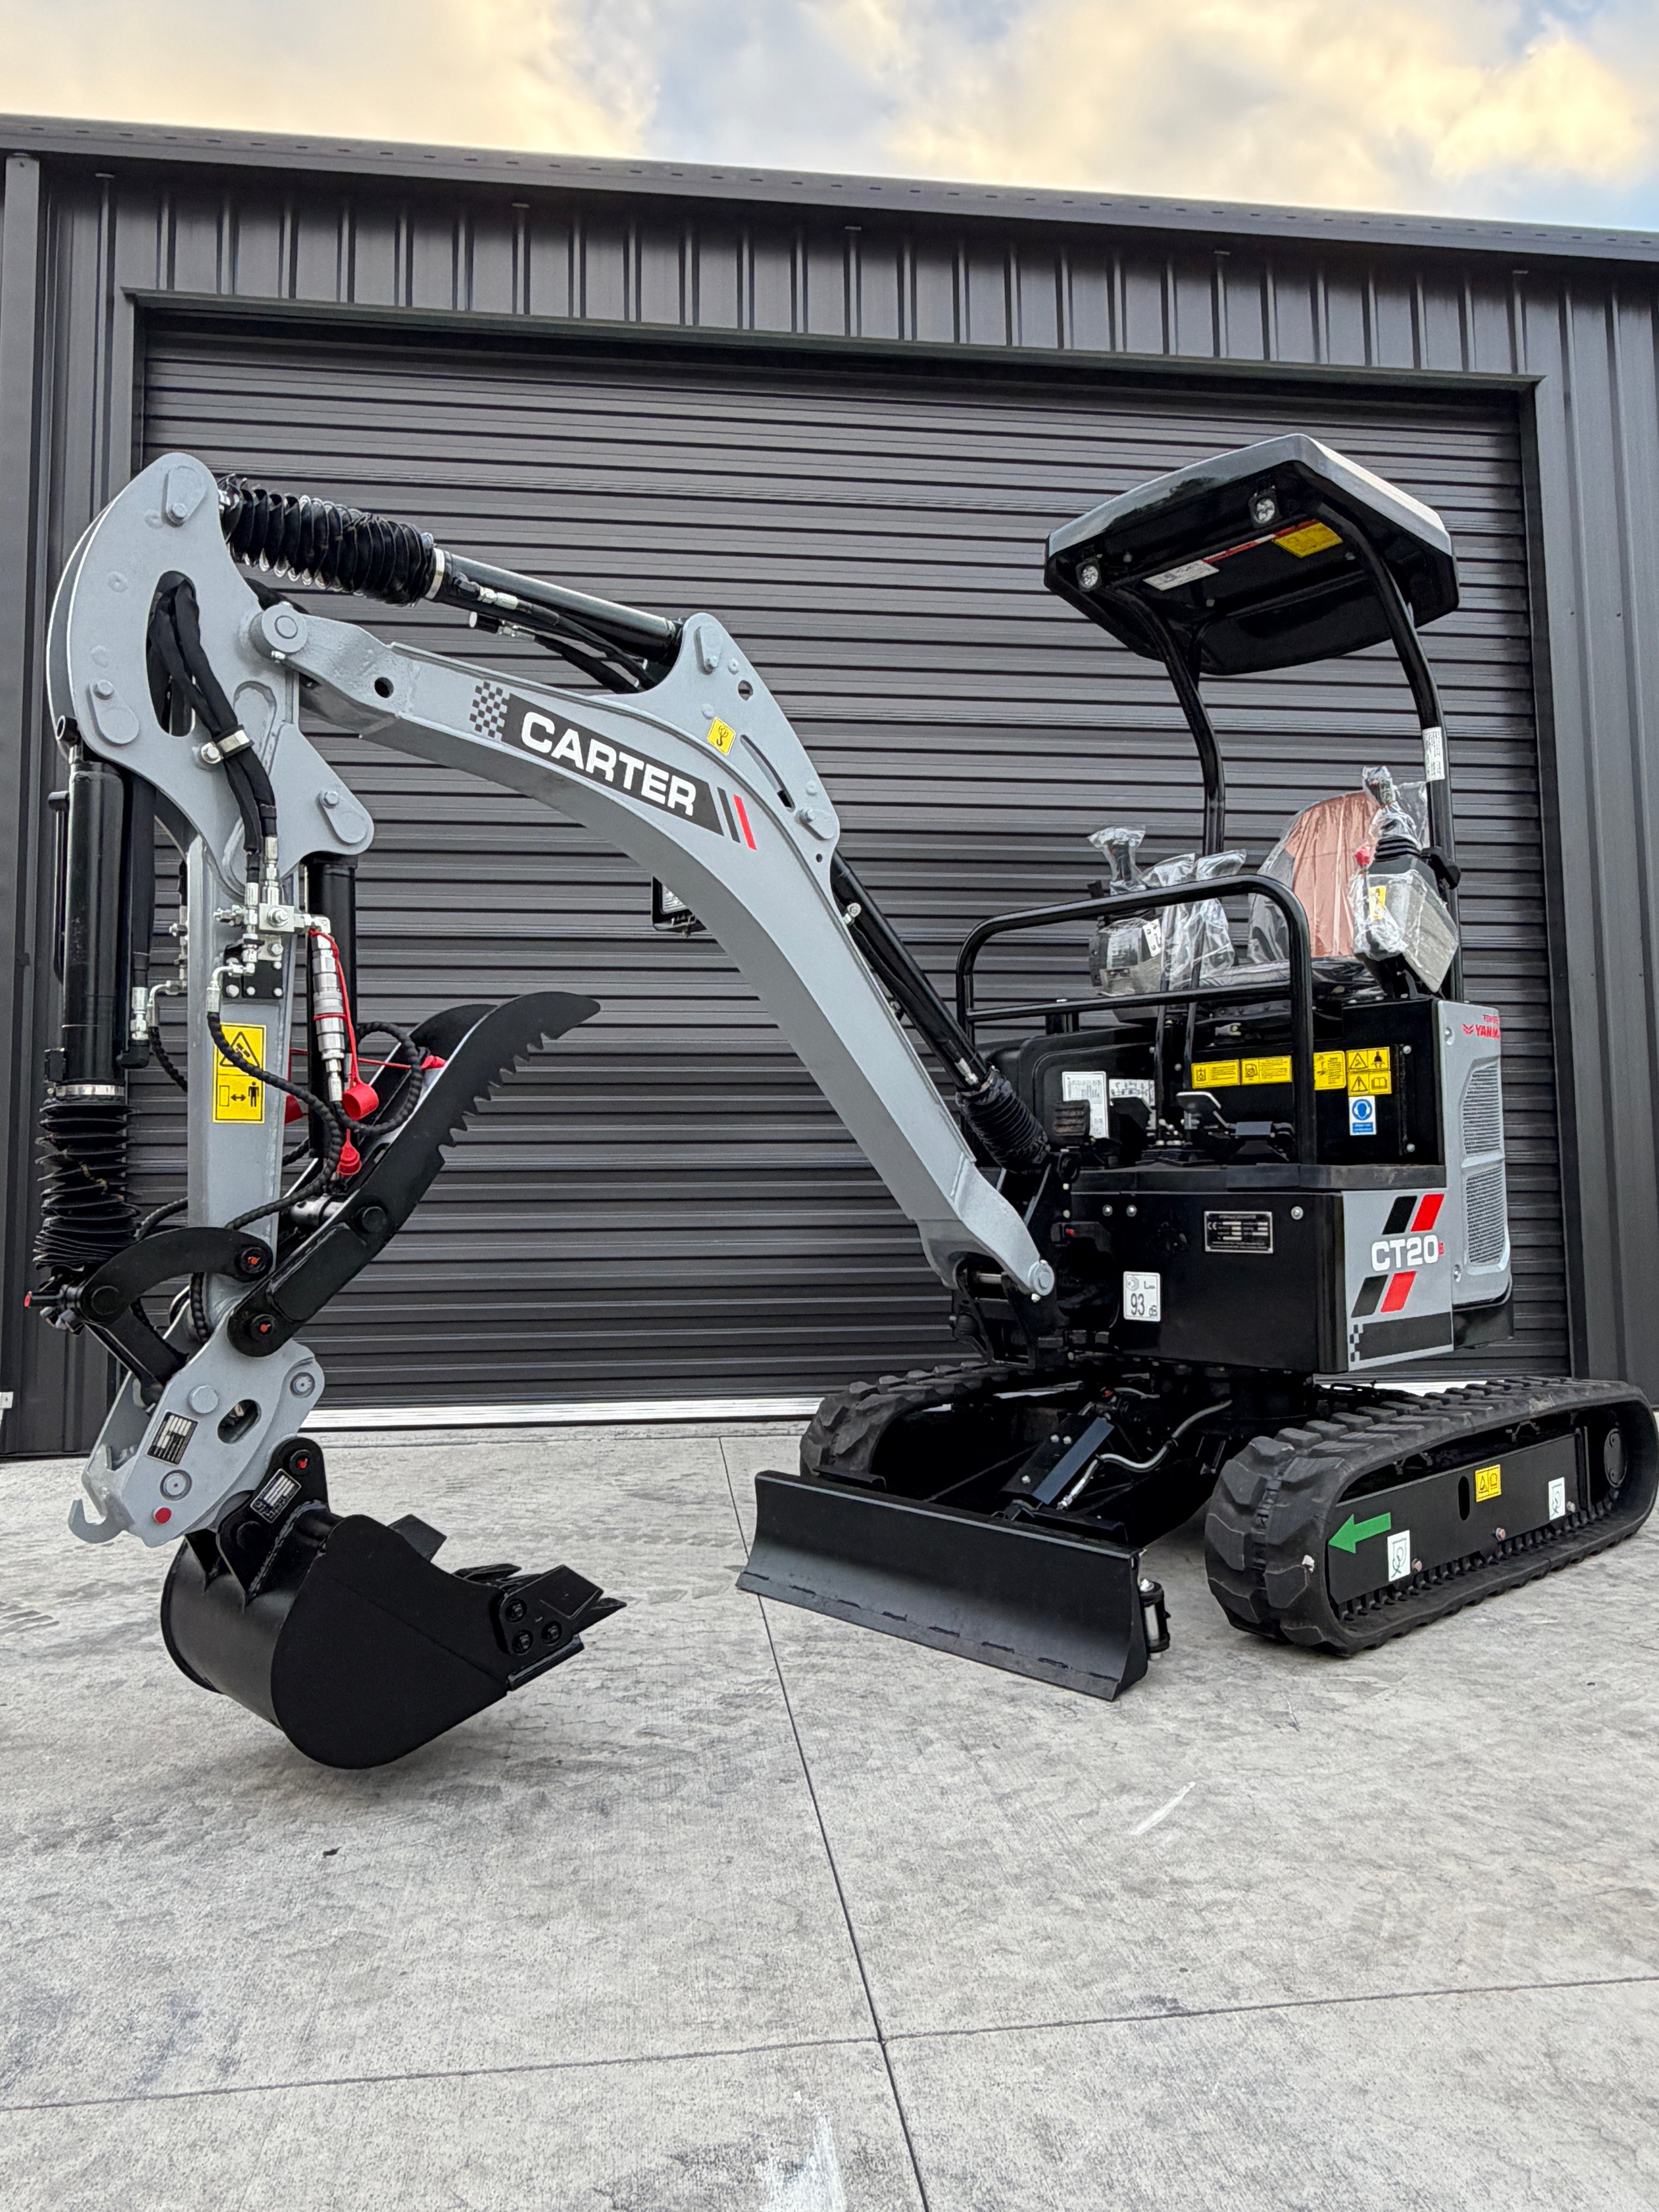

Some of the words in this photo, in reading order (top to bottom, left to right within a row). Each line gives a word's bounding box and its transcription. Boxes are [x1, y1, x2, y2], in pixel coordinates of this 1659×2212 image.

[521, 712, 696, 816] CARTER
[1475, 1024, 1500, 1039] YANM
[1131, 1293, 1145, 1316] 93
